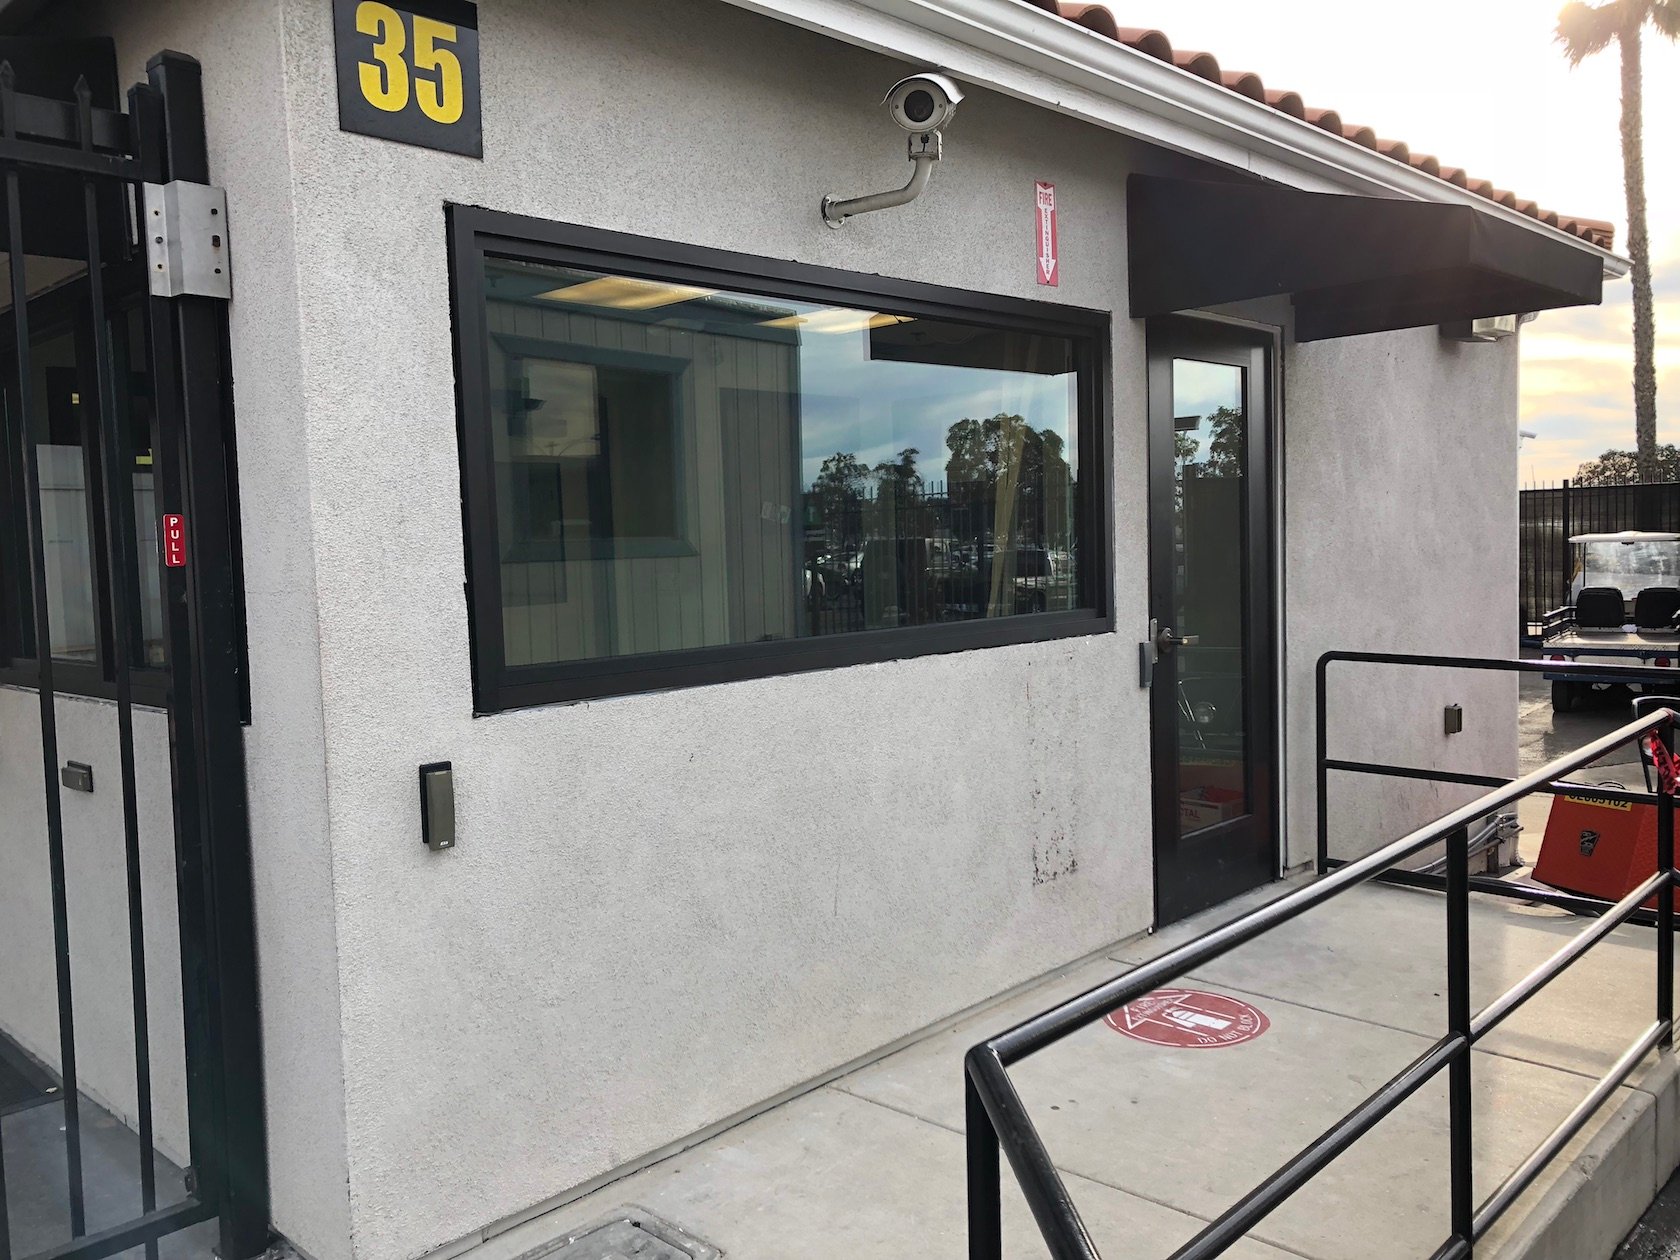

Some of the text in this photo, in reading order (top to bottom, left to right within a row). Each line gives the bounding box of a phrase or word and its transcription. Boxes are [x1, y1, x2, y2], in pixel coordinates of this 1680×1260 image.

[356, 1, 464, 124] 35
[1039, 192, 1052, 206] FIRE
[170, 517, 180, 564] PULL
[1197, 1036, 1218, 1044] DO
[1218, 1030, 1243, 1041] NOT
